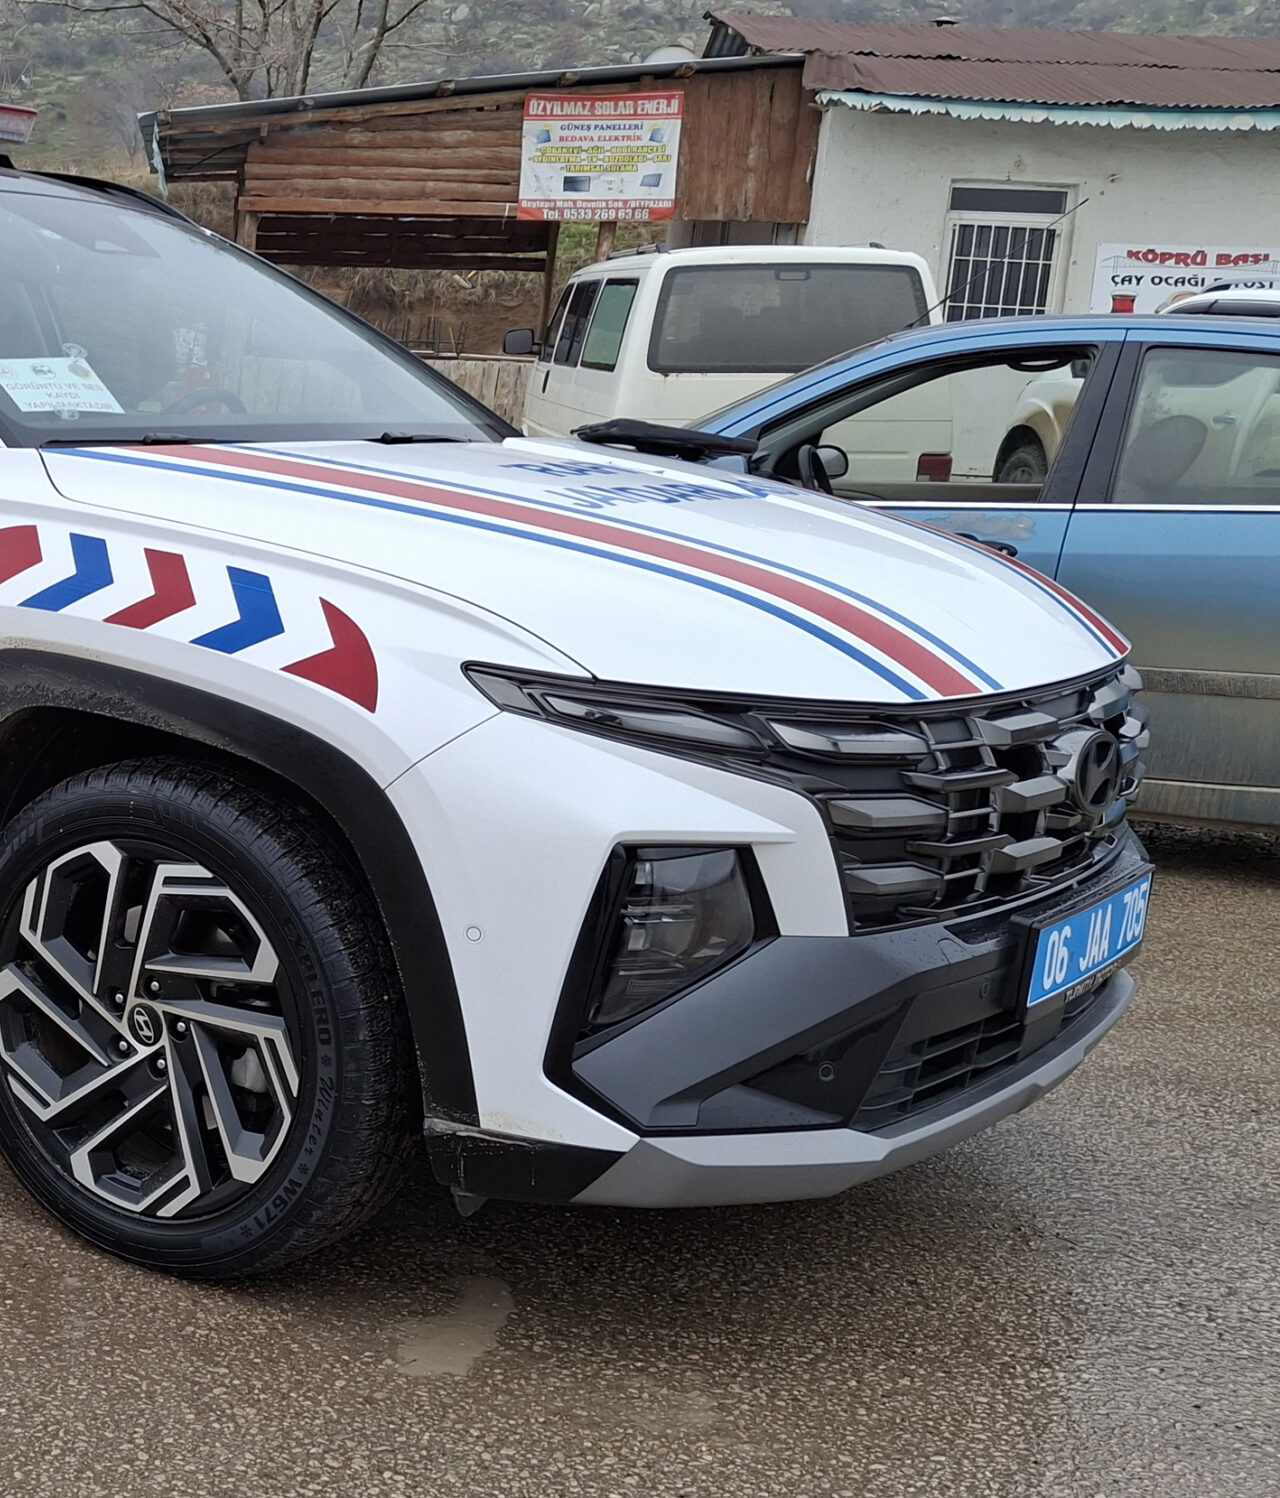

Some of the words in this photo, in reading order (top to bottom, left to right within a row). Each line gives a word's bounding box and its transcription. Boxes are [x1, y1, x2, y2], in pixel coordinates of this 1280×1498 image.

[529, 98, 591, 115] ÖZYILMAZ
[594, 101, 634, 115] SOLAR
[637, 95, 679, 114] ENERJİ
[560, 123, 591, 132] GÜNEŞ
[593, 121, 643, 131] PANELLERİ
[559, 135, 595, 143] BEDAVA
[597, 133, 643, 143] ELEKTRİK
[542, 209, 561, 219] Tel:
[564, 209, 592, 219] 0533
[594, 209, 616, 219] 269
[618, 209, 632, 219] 63
[634, 209, 649, 219] 66
[1126, 249, 1208, 267] KÖPRÜ
[1215, 253, 1271, 266] BAŞI
[1111, 274, 1145, 287] ÇAY
[1150, 274, 1206, 287] OCAĞI
[1042, 925, 1072, 990] 06
[1079, 903, 1112, 973] JAA
[1117, 881, 1149, 950] 705
[254, 1178, 303, 1231] W671
